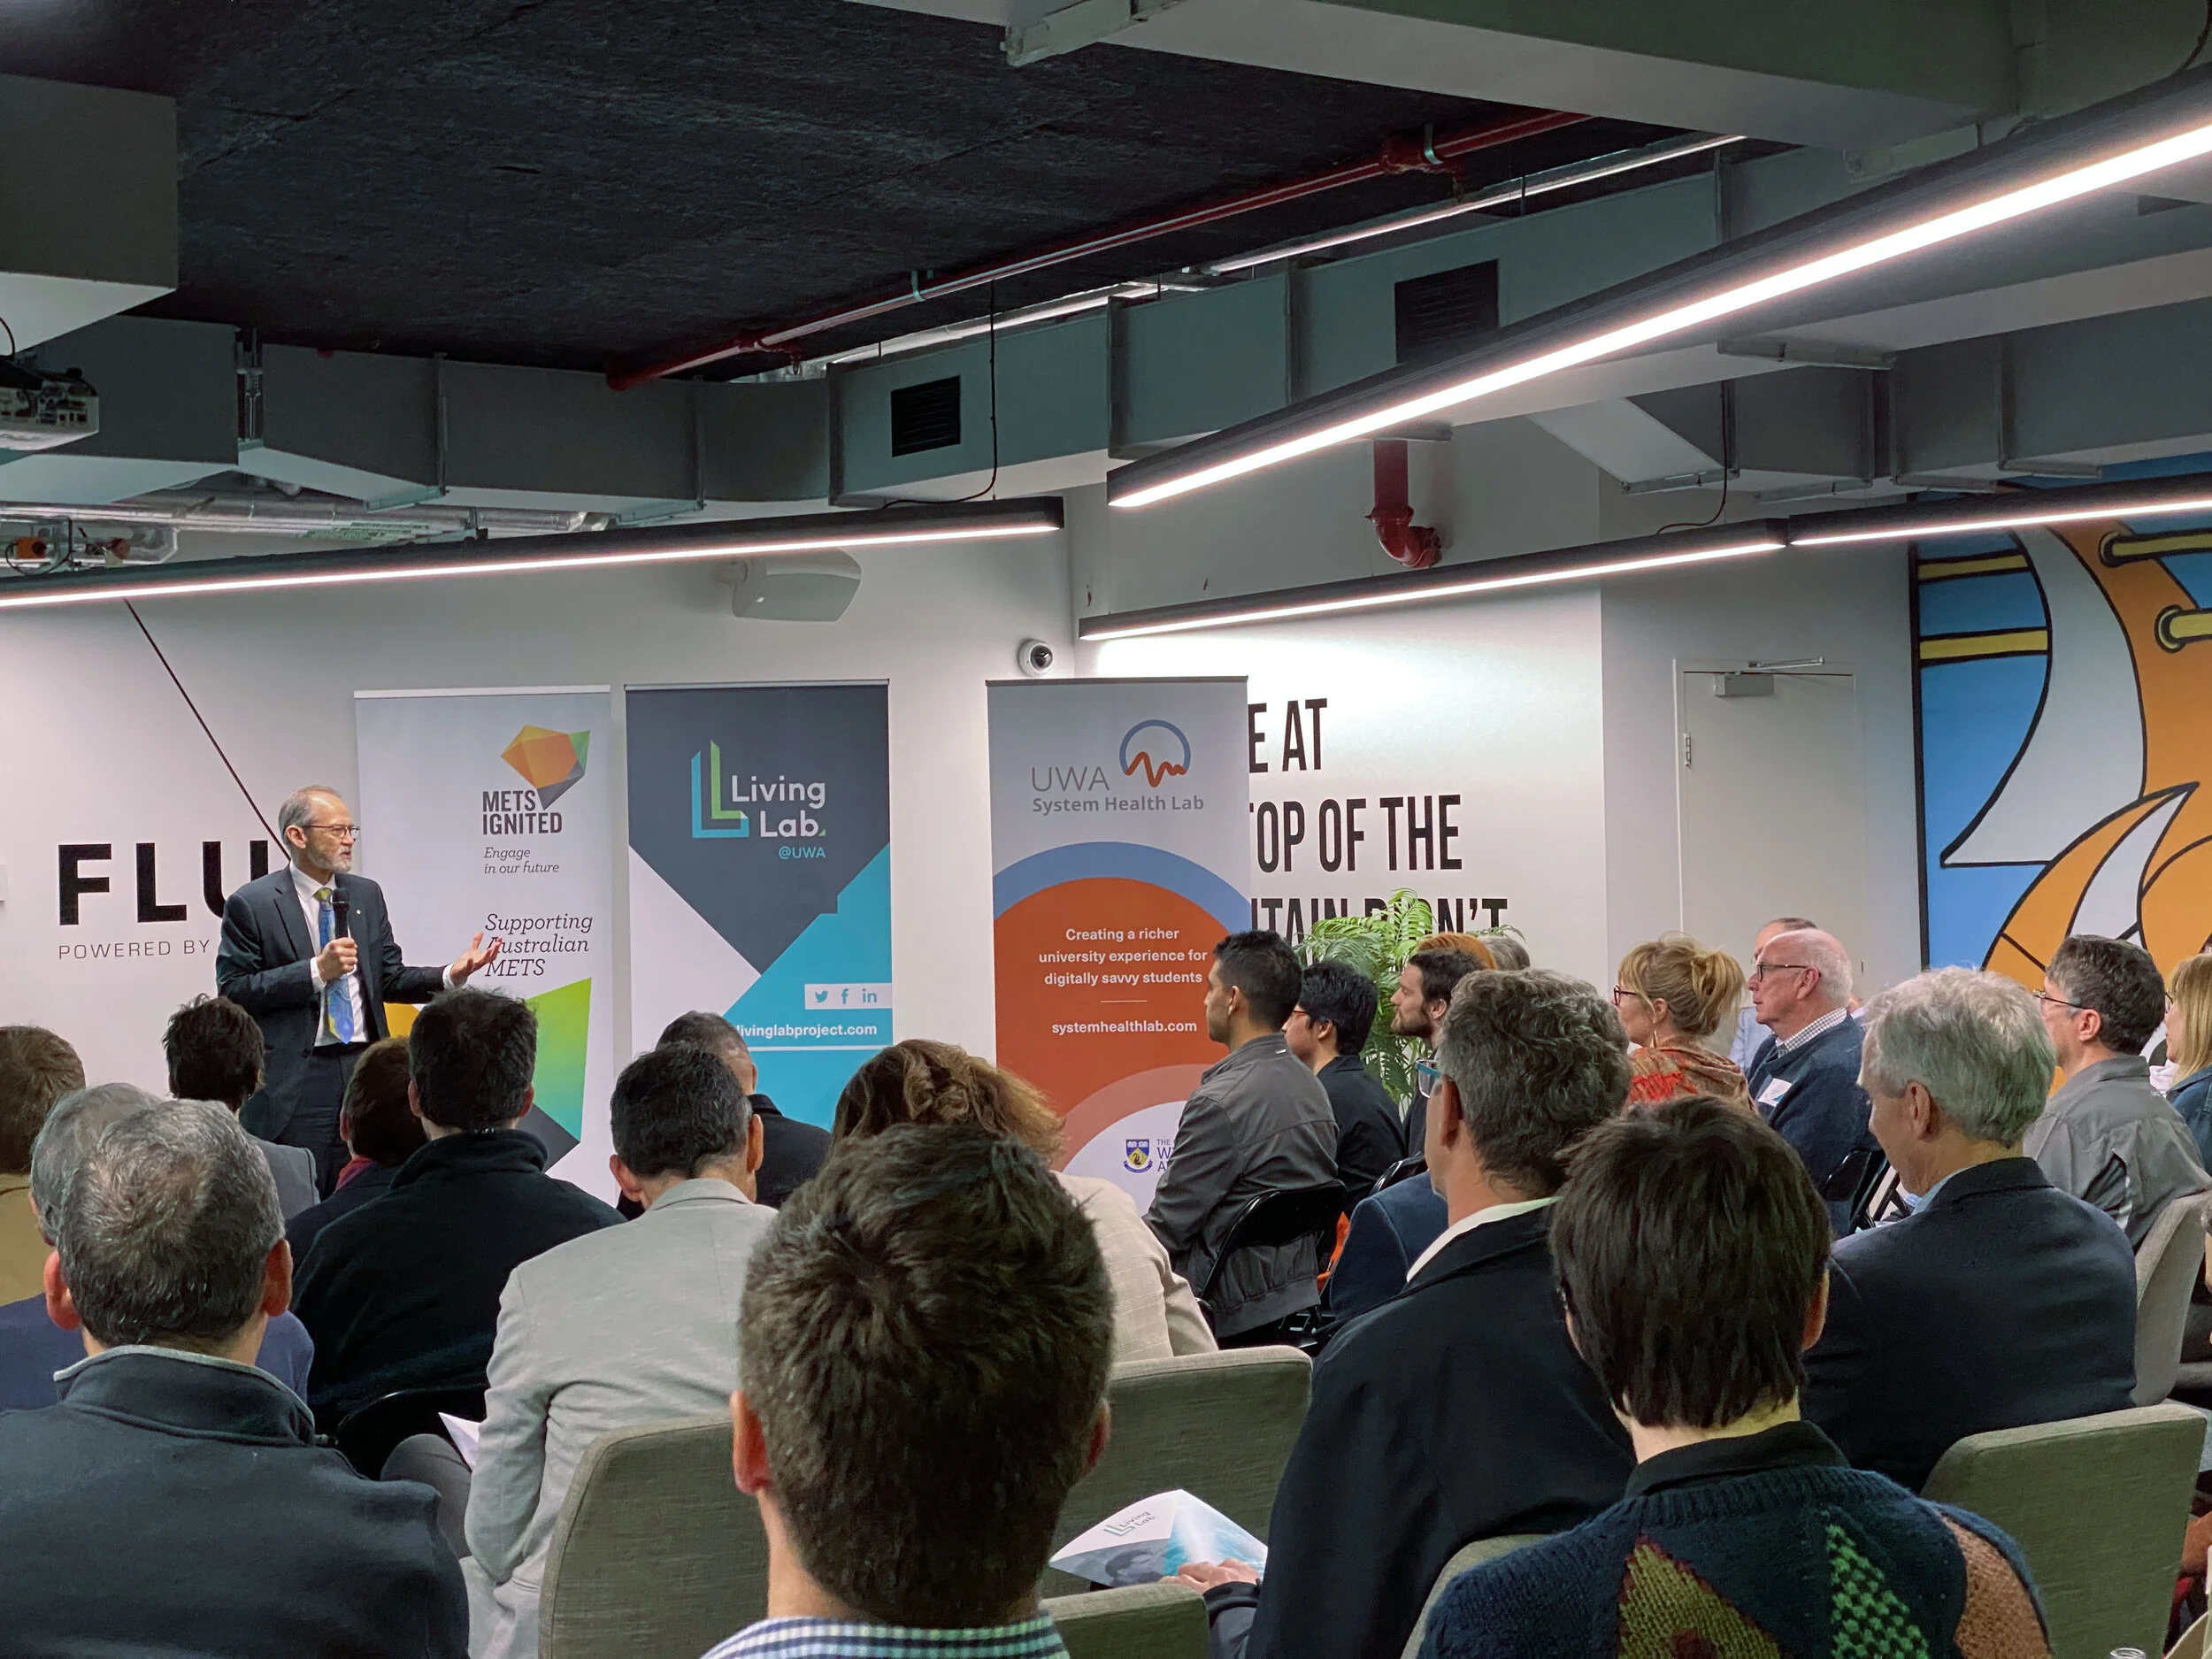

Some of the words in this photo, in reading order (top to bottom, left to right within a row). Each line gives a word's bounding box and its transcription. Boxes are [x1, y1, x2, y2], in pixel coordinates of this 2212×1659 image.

[1282, 697, 1327, 772] AT
[1032, 766, 1110, 792] UWA
[482, 790, 536, 812] METS
[732, 775, 826, 810] Living
[1033, 798, 1099, 816] System
[1105, 796, 1165, 811] Health
[1172, 795, 1204, 810] Lab
[482, 812, 563, 835] IGNITED
[1249, 801, 1305, 873] OP
[1319, 798, 1367, 872] OF
[1380, 795, 1463, 871] THE
[484, 847, 531, 861] Engage
[779, 845, 826, 859] @UWA
[484, 863, 496, 874] in
[499, 864, 520, 874] our
[523, 860, 560, 873] future
[58, 840, 269, 926] FLU
[485, 913, 593, 935] Supporting
[1065, 928, 1124, 942] Creating
[1127, 931, 1135, 940] a
[1139, 928, 1179, 940] richer
[59, 941, 171, 960] POWERED
[184, 939, 211, 955] BY
[1039, 950, 1106, 964] university
[1109, 949, 1185, 964] experience
[1188, 949, 1208, 961] for
[485, 958, 546, 977] METS
[1044, 972, 1098, 987] digitally
[1102, 974, 1139, 987] savvy
[1143, 972, 1202, 983] students
[1052, 1020, 1197, 1035] systemhealthlab.com
[1118, 1511, 1151, 1528] Living
